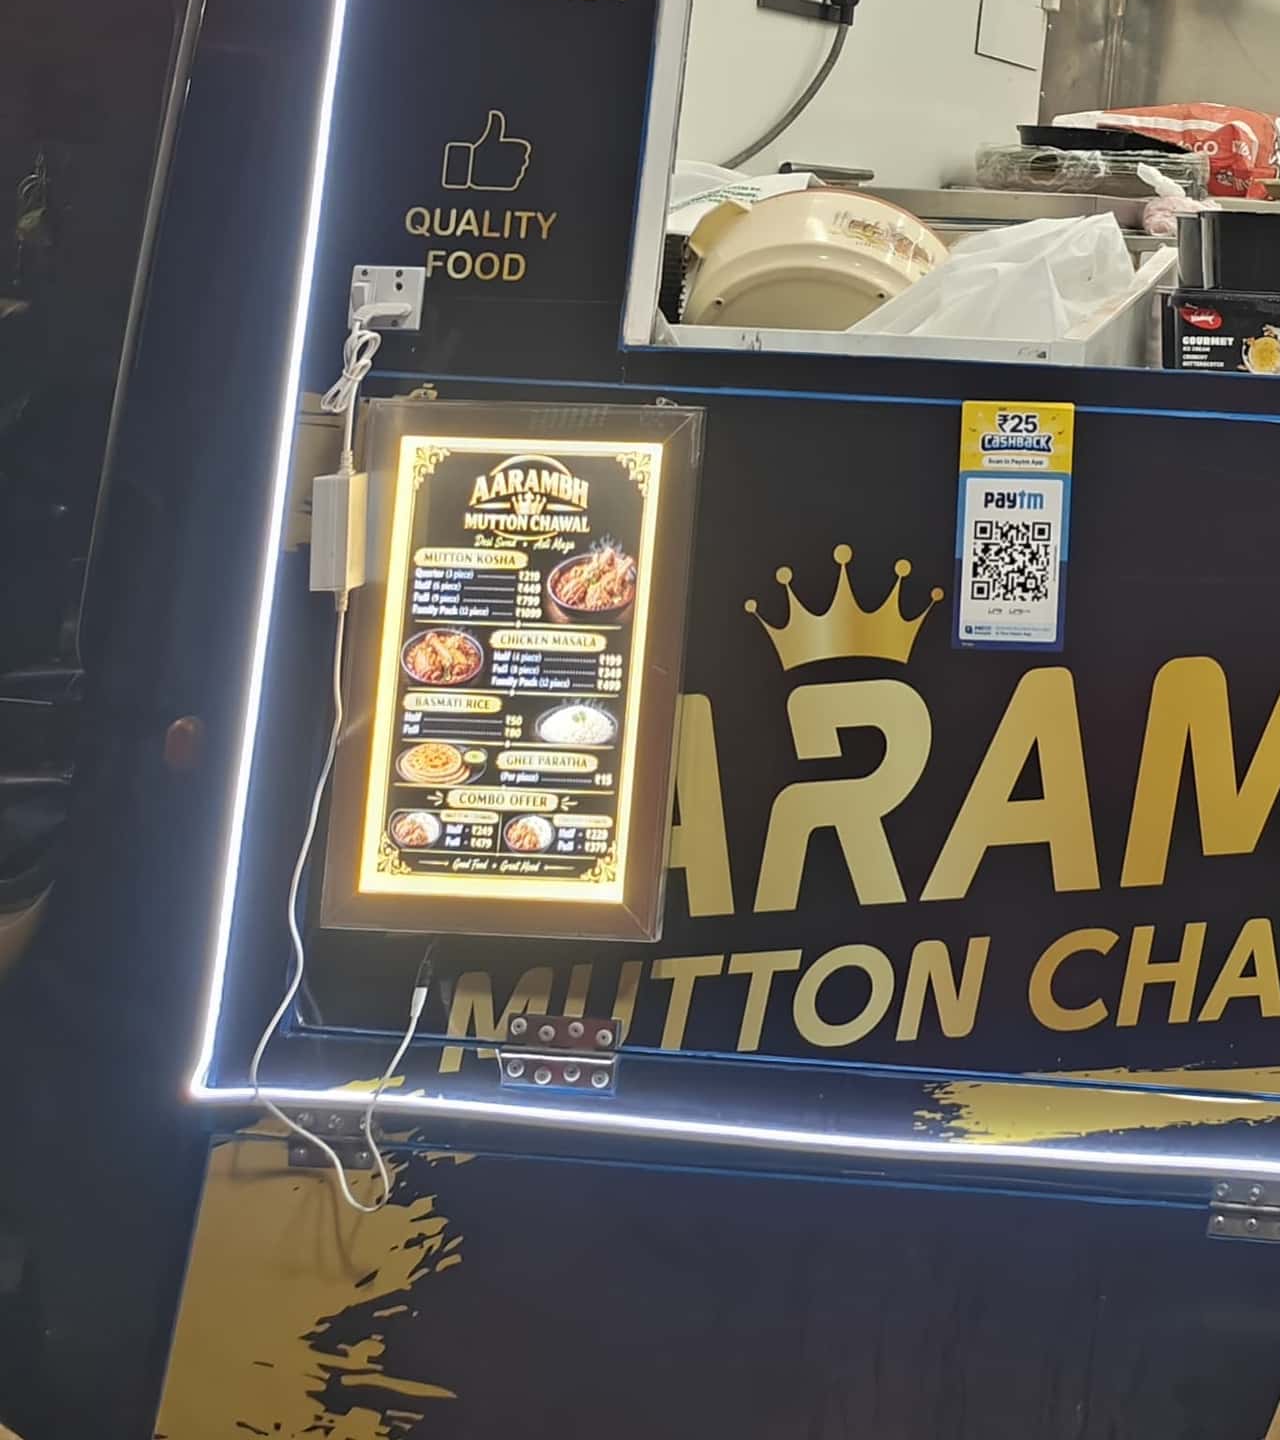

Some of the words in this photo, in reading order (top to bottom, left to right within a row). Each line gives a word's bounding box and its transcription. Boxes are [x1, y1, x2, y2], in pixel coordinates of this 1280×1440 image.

[405, 207, 557, 240] QUALITY
[426, 250, 527, 281] FOOD
[997, 414, 1037, 434] ₹25
[469, 469, 589, 509] AARAMBH
[984, 490, 1044, 509] paytm
[464, 513, 528, 530] MUTTON
[529, 514, 591, 532] CHAWAL
[424, 552, 472, 563] MUTTON
[476, 553, 516, 565] KOSHA
[500, 634, 548, 646] CHICKEN
[551, 636, 597, 648] MASALA
[415, 698, 462, 708] BASMATI
[465, 699, 490, 709] RICE
[538, 755, 588, 768] PARATHA
[459, 792, 505, 805] COMBO
[509, 793, 548, 807] OFFER
